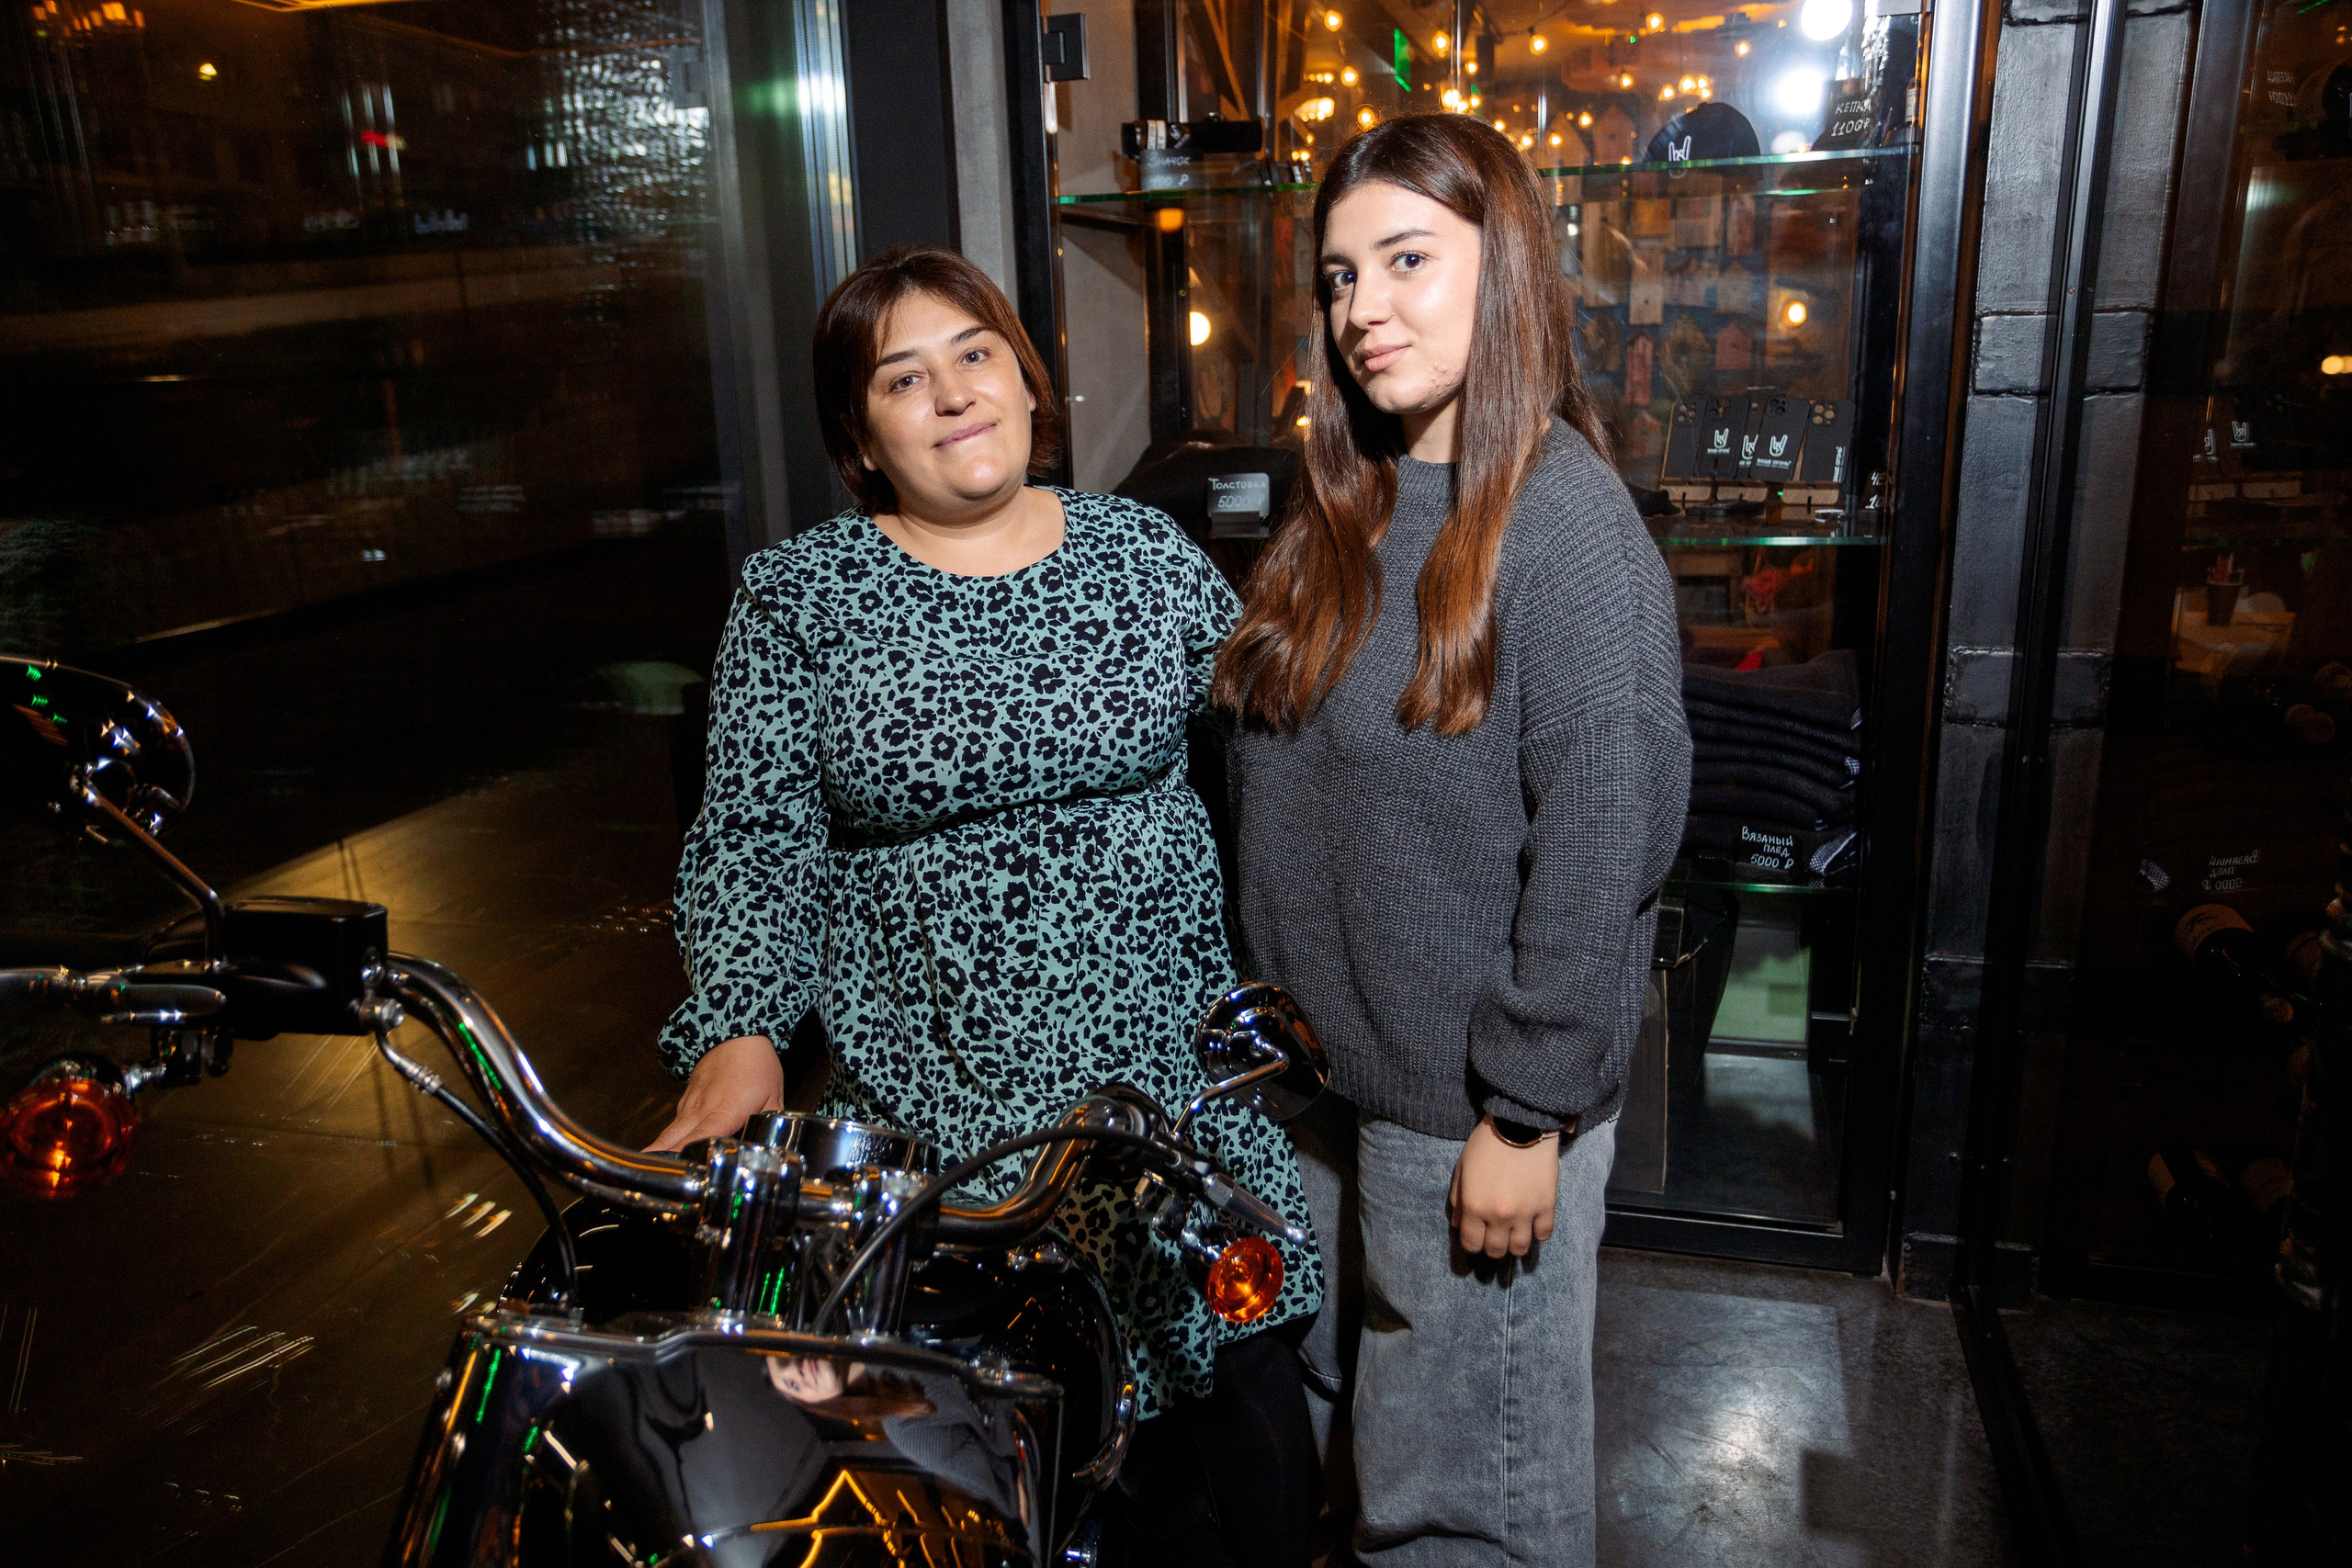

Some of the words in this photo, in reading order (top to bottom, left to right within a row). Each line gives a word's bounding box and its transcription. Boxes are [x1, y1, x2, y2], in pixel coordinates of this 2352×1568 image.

[1835, 99, 1871, 115] КЕПКА
[1208, 477, 1267, 491] ТОЛСТОВКА
[1217, 495, 1250, 508] 5000
[1741, 826, 1793, 847] ВЯЗАНЫЙ
[1763, 843, 1791, 858] ПЛЕД
[1750, 853, 1780, 868] 5000
